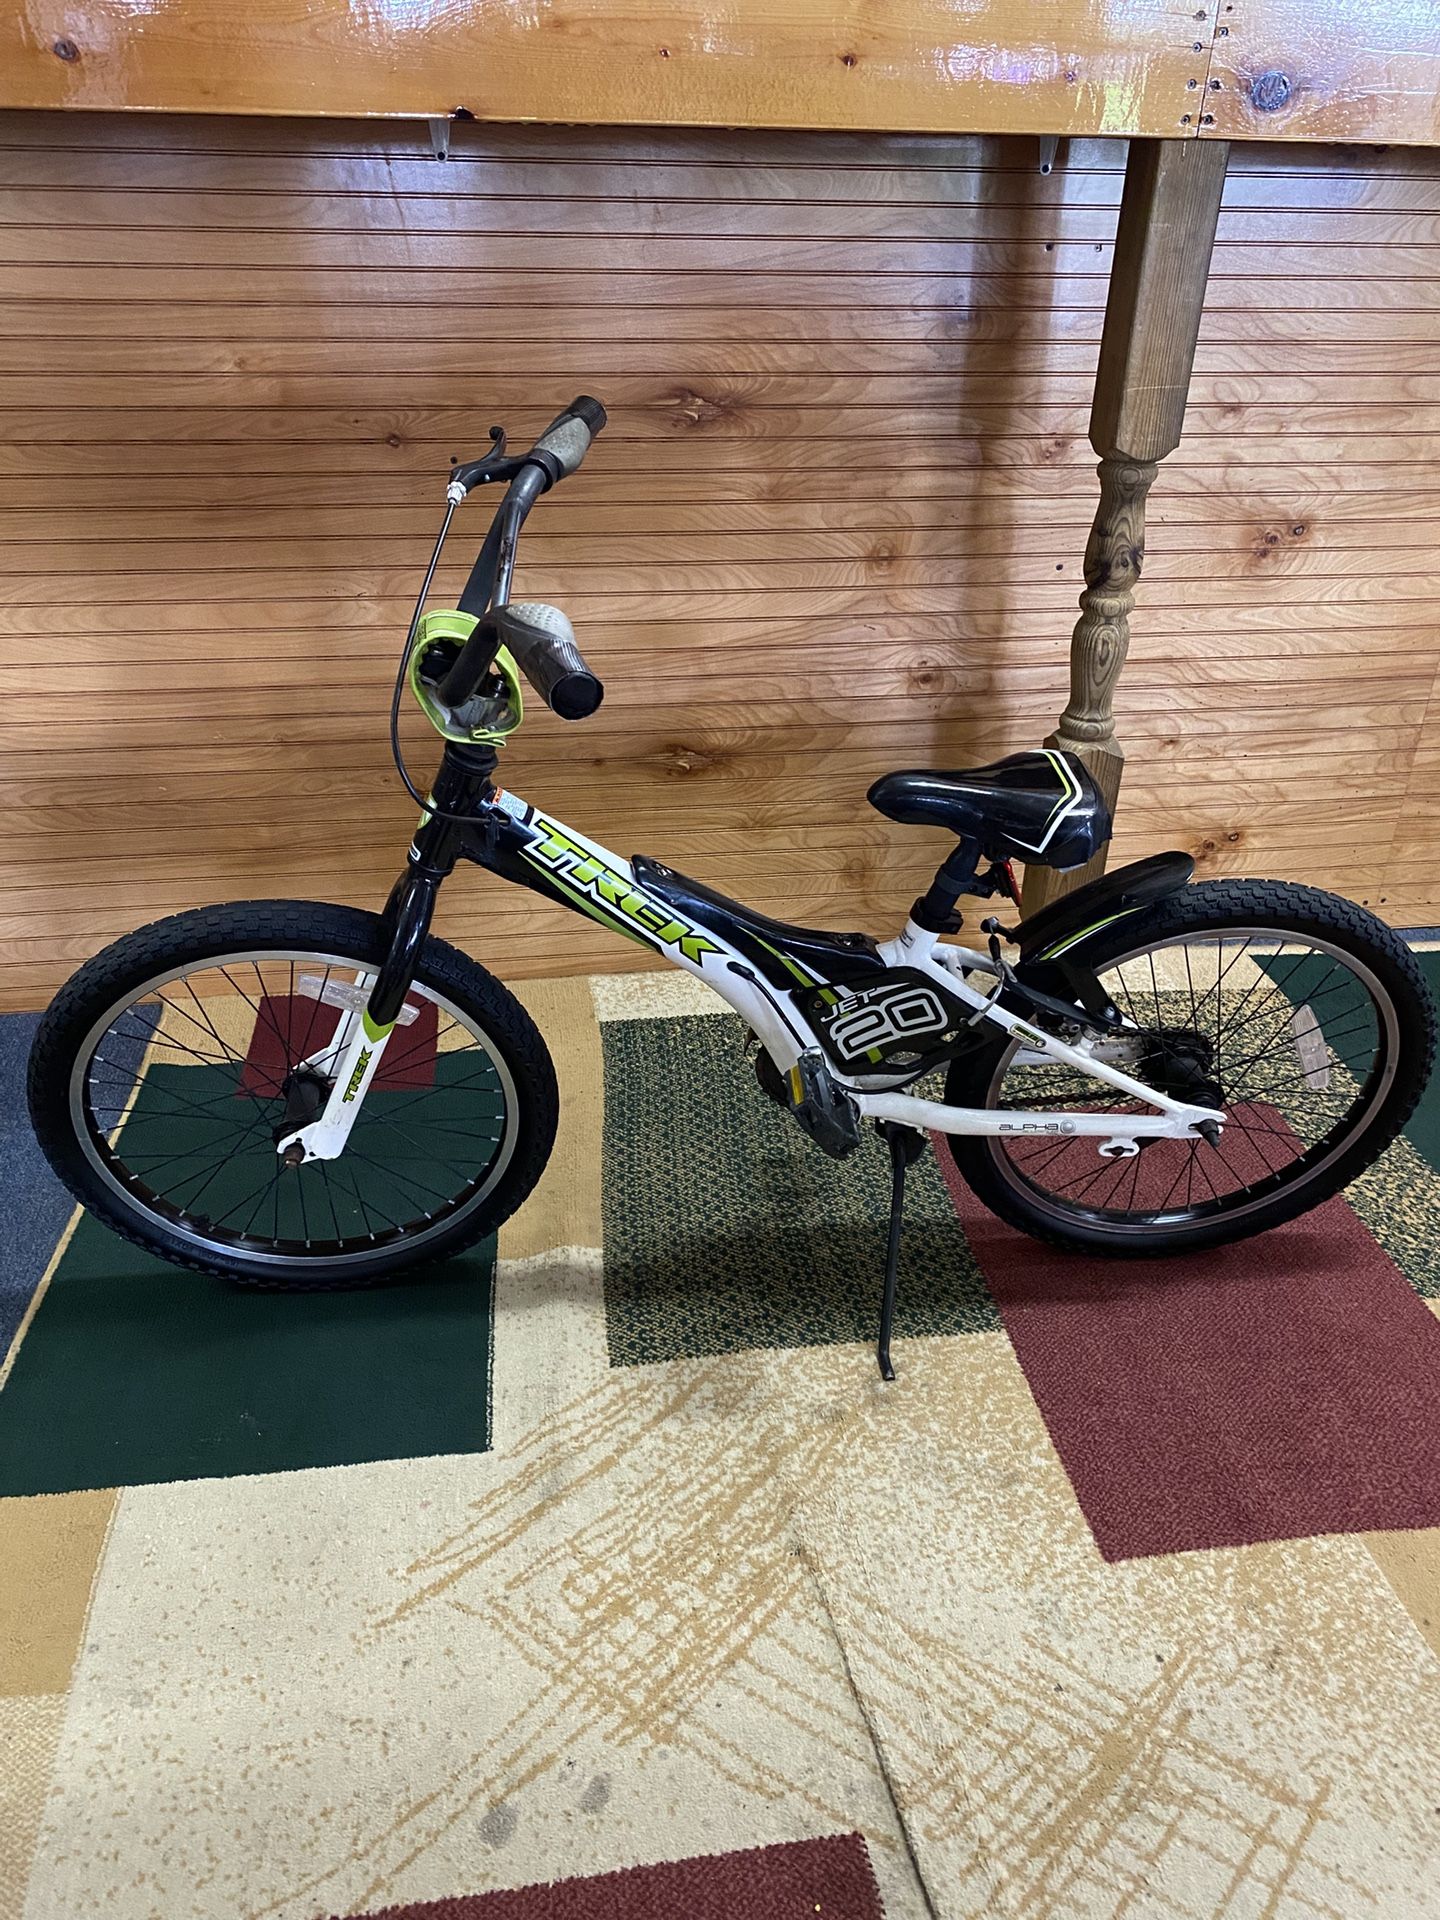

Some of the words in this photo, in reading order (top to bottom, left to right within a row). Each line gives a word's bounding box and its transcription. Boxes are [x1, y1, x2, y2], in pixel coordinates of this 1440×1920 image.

[532, 818, 728, 967] TREK
[820, 987, 876, 1023] JET
[829, 988, 949, 1061] 20
[342, 1045, 373, 1103] TREK
